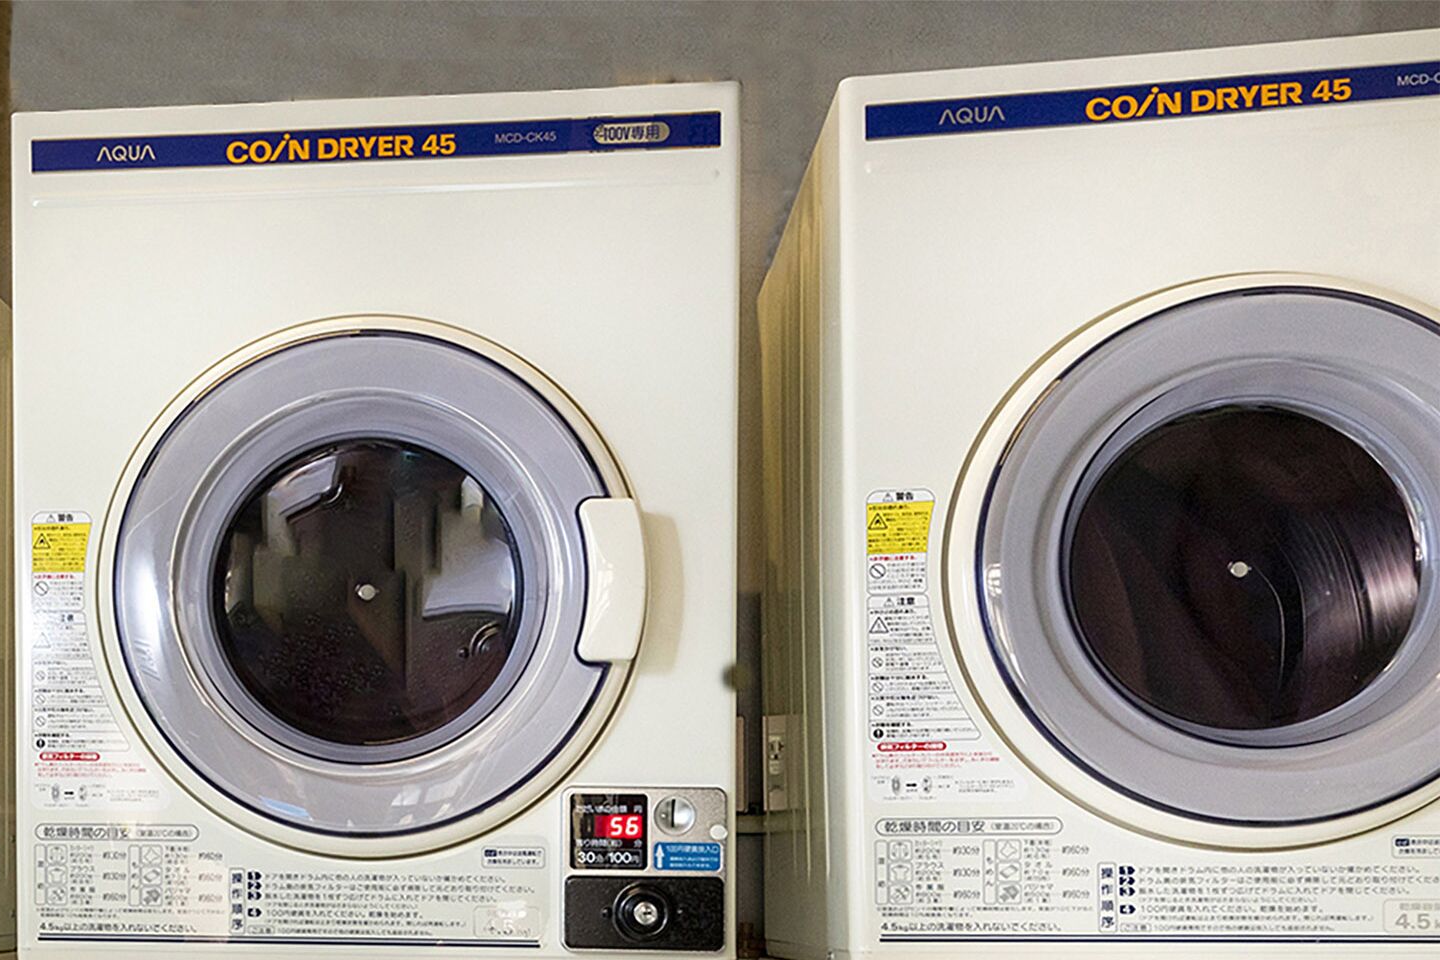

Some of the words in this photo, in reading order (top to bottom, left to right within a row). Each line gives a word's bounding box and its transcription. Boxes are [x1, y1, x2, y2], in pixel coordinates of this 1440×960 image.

[1191, 83, 1302, 113] DRYER
[1311, 77, 1353, 102] 45
[939, 105, 1006, 125] AQUA
[318, 135, 414, 160] DRYER
[422, 133, 456, 156] 45
[494, 131, 557, 144] MCD-CK45
[96, 144, 156, 163] AQUA
[610, 816, 639, 836] 56
[885, 821, 986, 833] 乾燥時間の目安
[1395, 914, 1431, 929] 4.5
